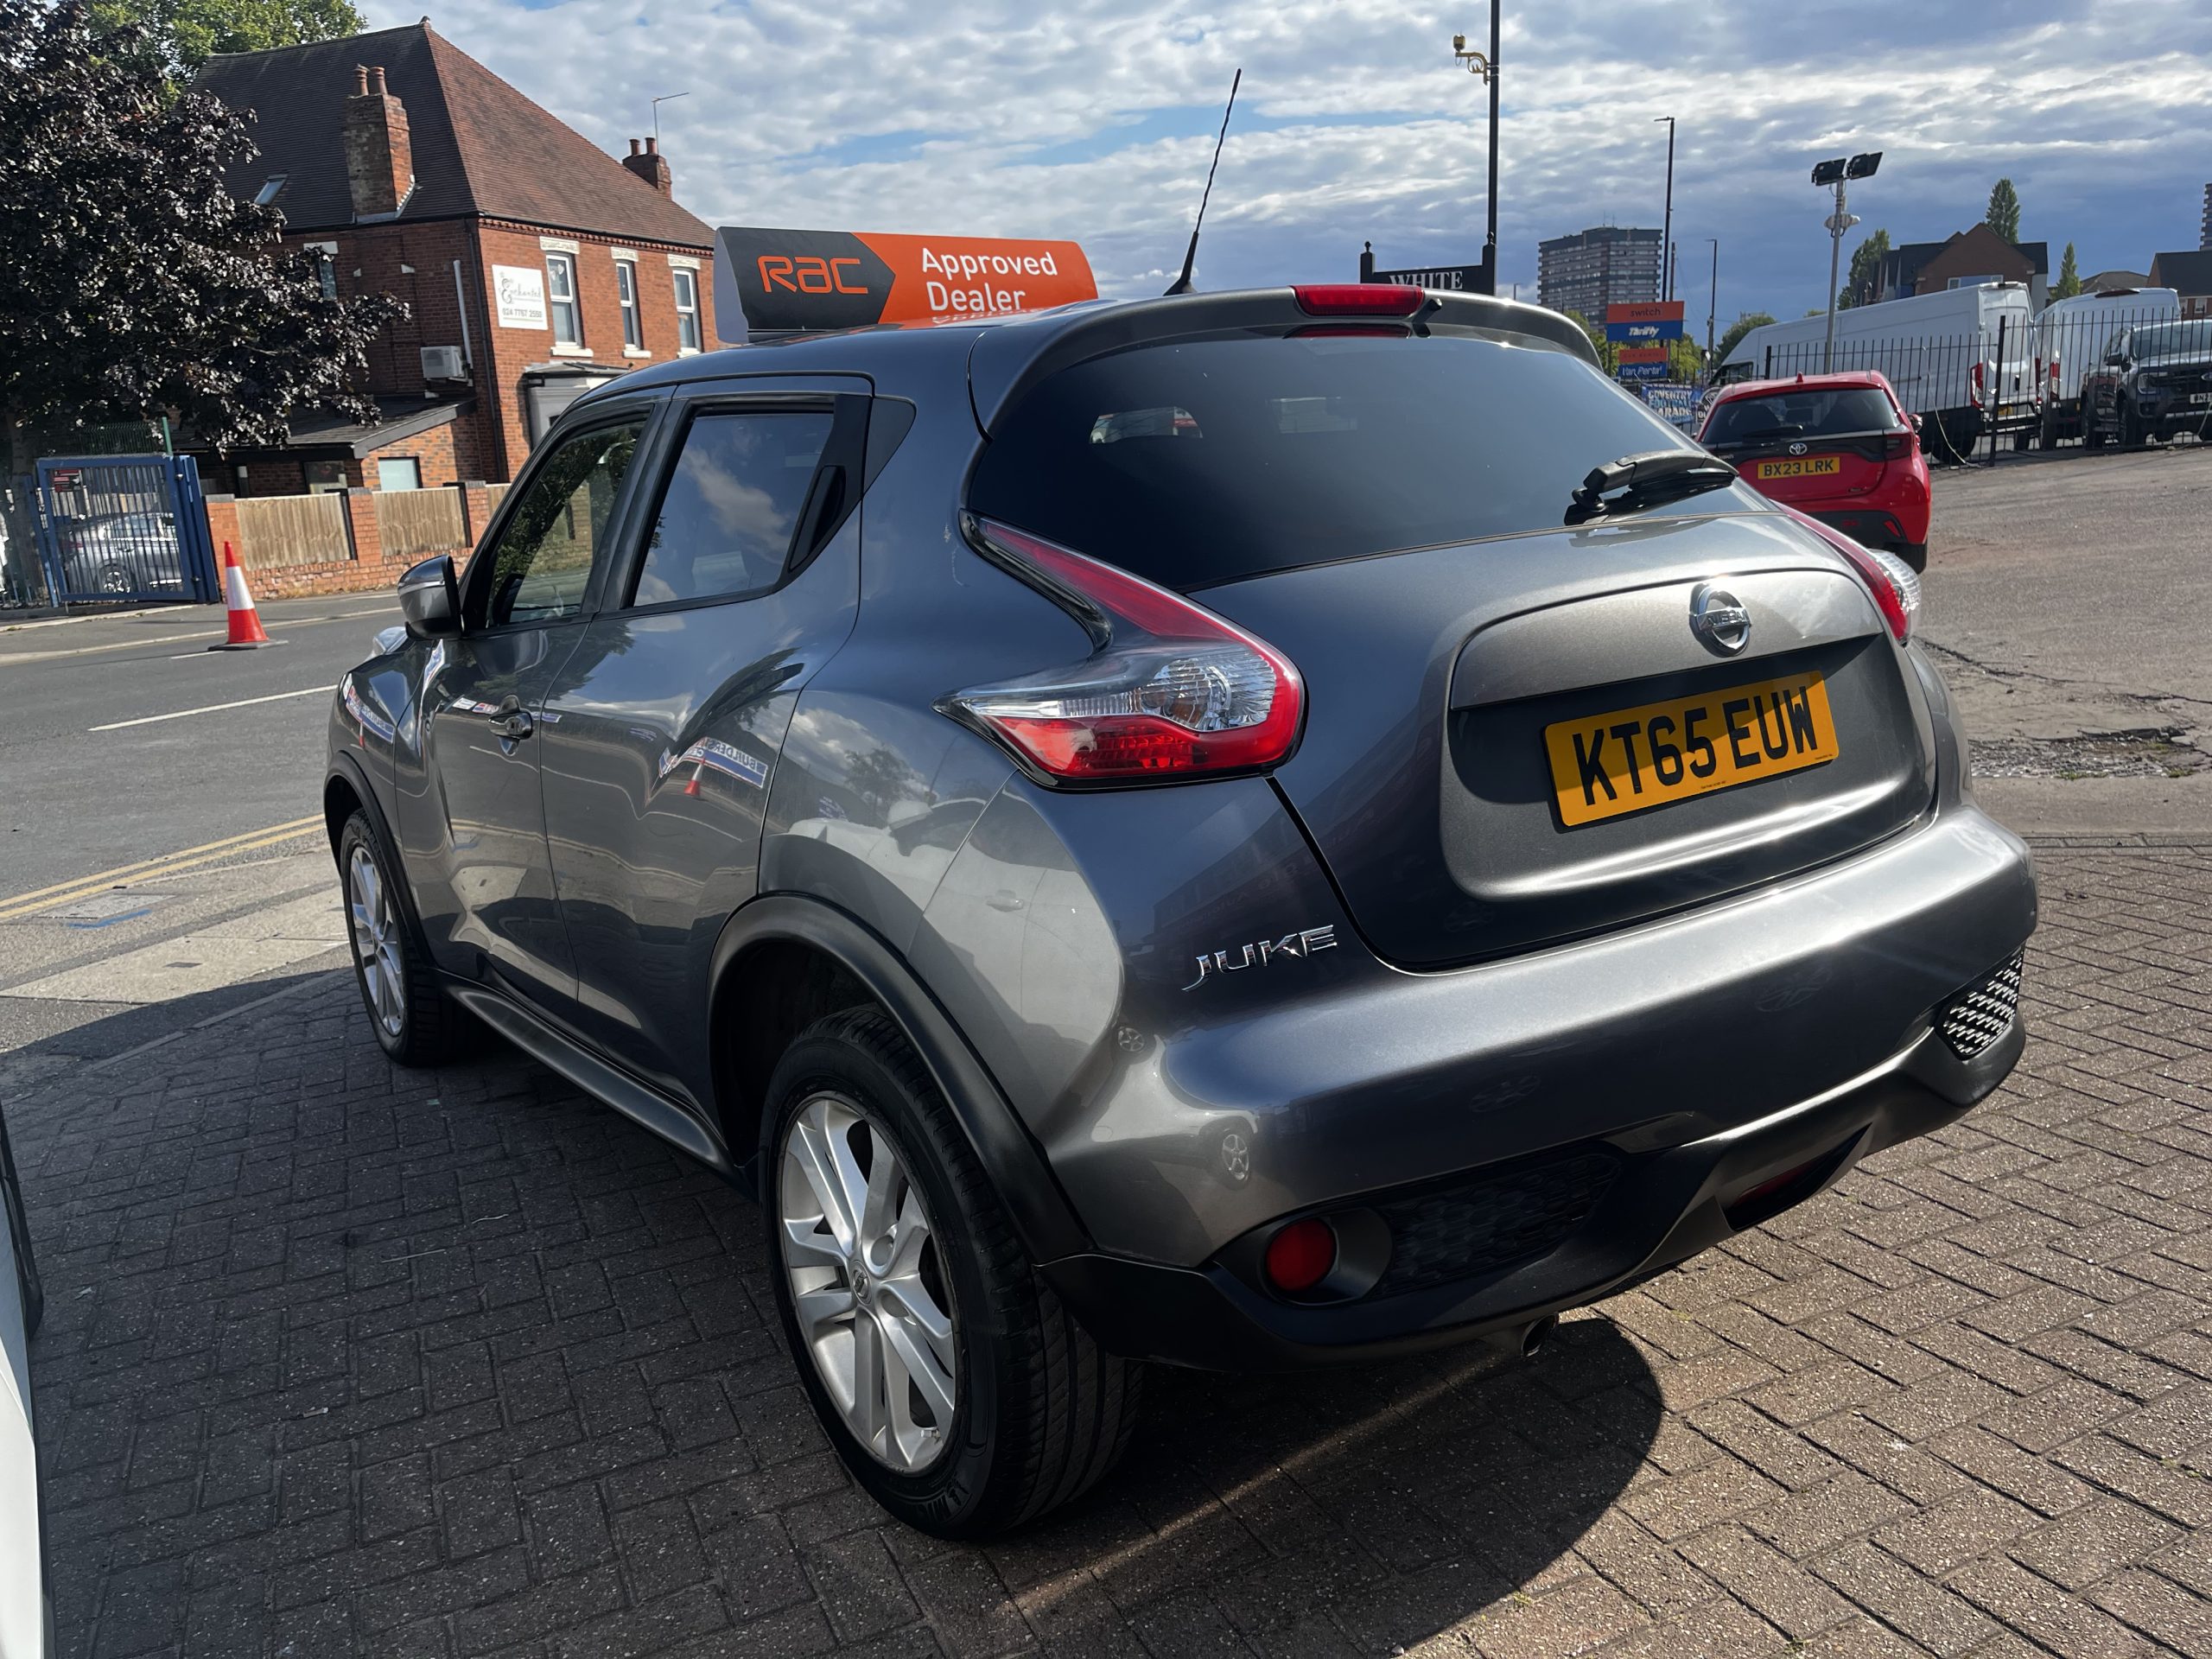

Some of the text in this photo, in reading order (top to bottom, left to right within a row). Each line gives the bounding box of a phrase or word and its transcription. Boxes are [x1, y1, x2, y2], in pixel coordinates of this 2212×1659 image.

[921, 247, 1058, 281] Approved
[1389, 270, 1463, 290] WHITE
[925, 281, 1027, 313] Dealer
[1630, 308, 1662, 317] switch
[1628, 326, 1660, 338] Thrifty
[1648, 390, 1693, 400] COVENTRY
[1764, 459, 1834, 478] BX23 LRK
[1572, 685, 1818, 806] KT65 EUW
[1181, 925, 1338, 993] JUKE
